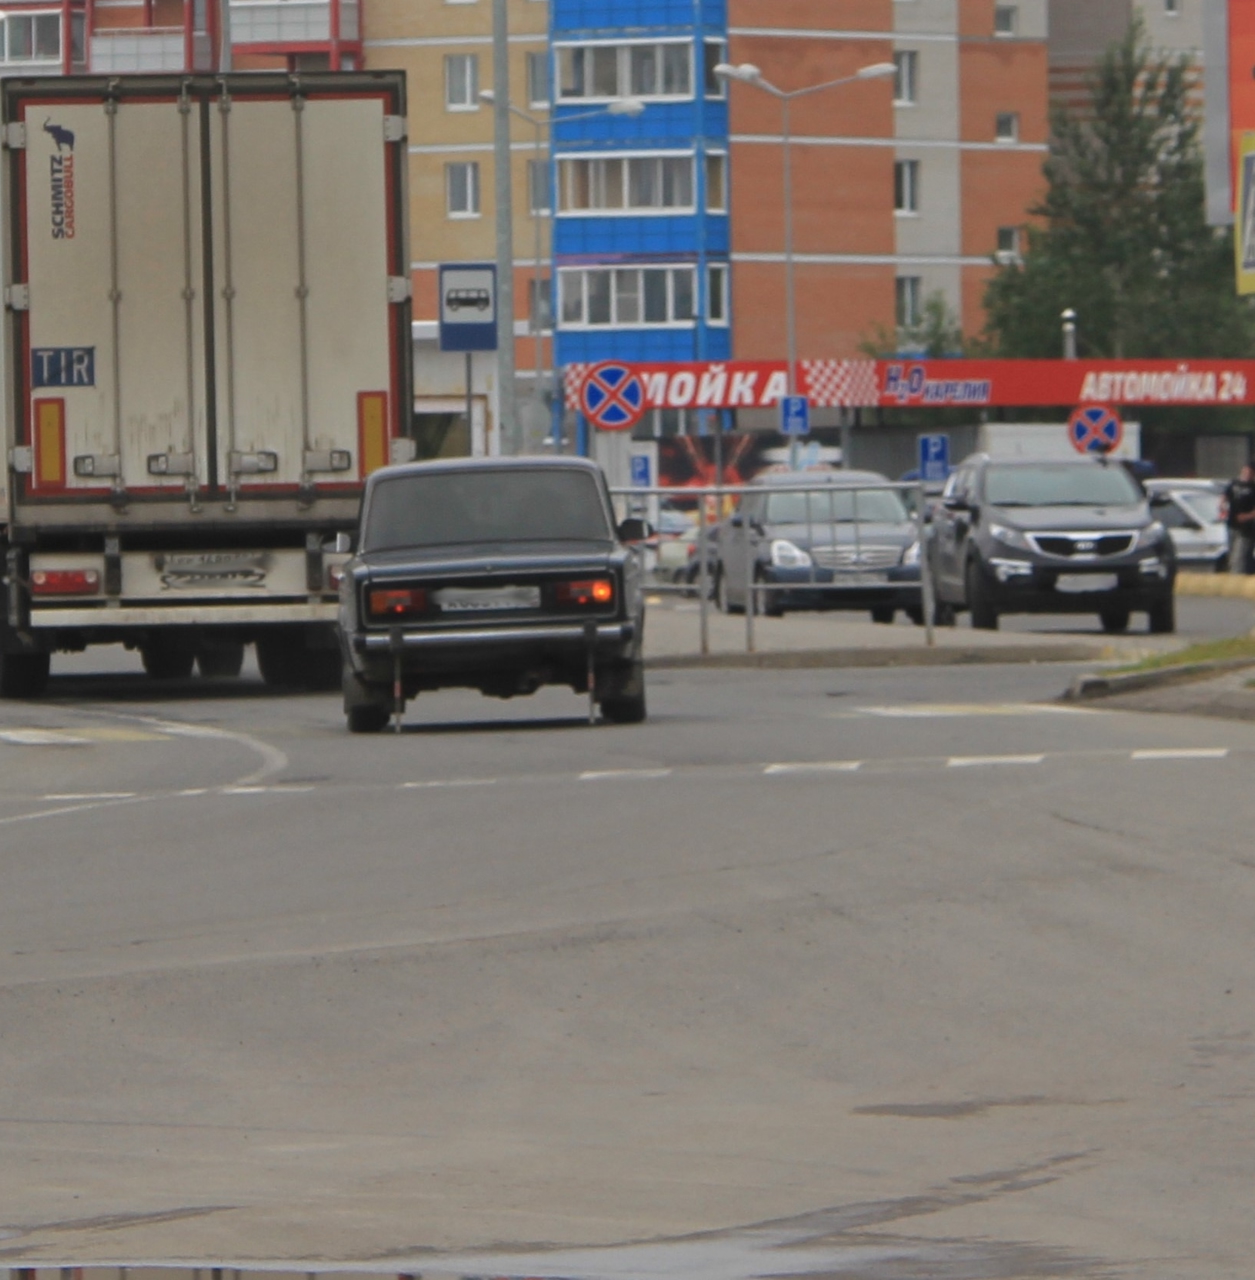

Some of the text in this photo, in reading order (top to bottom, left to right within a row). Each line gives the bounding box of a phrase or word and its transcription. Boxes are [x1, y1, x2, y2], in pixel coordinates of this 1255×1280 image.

[50, 154, 64, 239] SCHMITZ
[64, 153, 75, 239] CARGOBULL
[36, 350, 89, 384] TIR
[1079, 362, 1247, 401] АВТОМОЙКА 24
